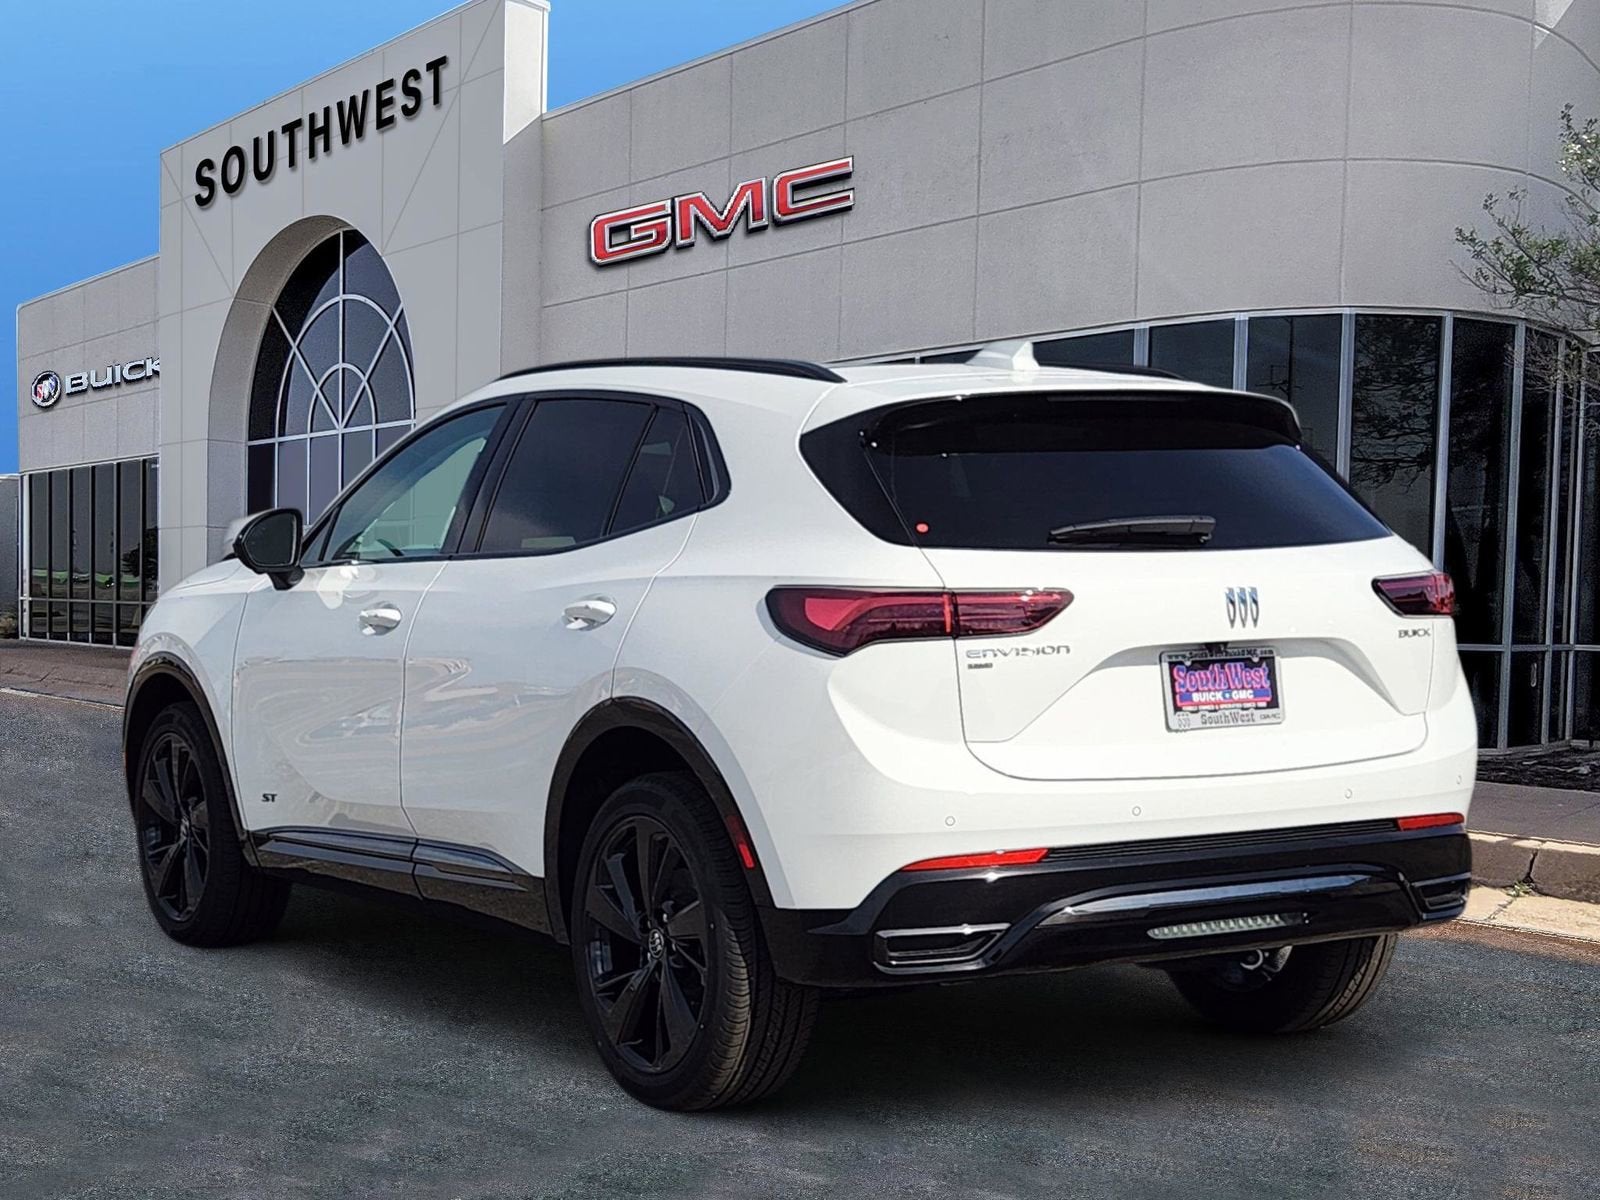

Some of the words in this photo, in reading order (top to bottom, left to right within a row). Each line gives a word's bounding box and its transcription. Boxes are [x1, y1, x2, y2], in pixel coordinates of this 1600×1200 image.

[195, 55, 448, 208] SOUTHWEST
[589, 155, 855, 267] GMC
[64, 357, 160, 396] BUICK
[1398, 628, 1431, 639] BUICK
[1191, 691, 1223, 702] BUICK
[1232, 689, 1254, 700] GMC
[261, 793, 278, 803] ST
